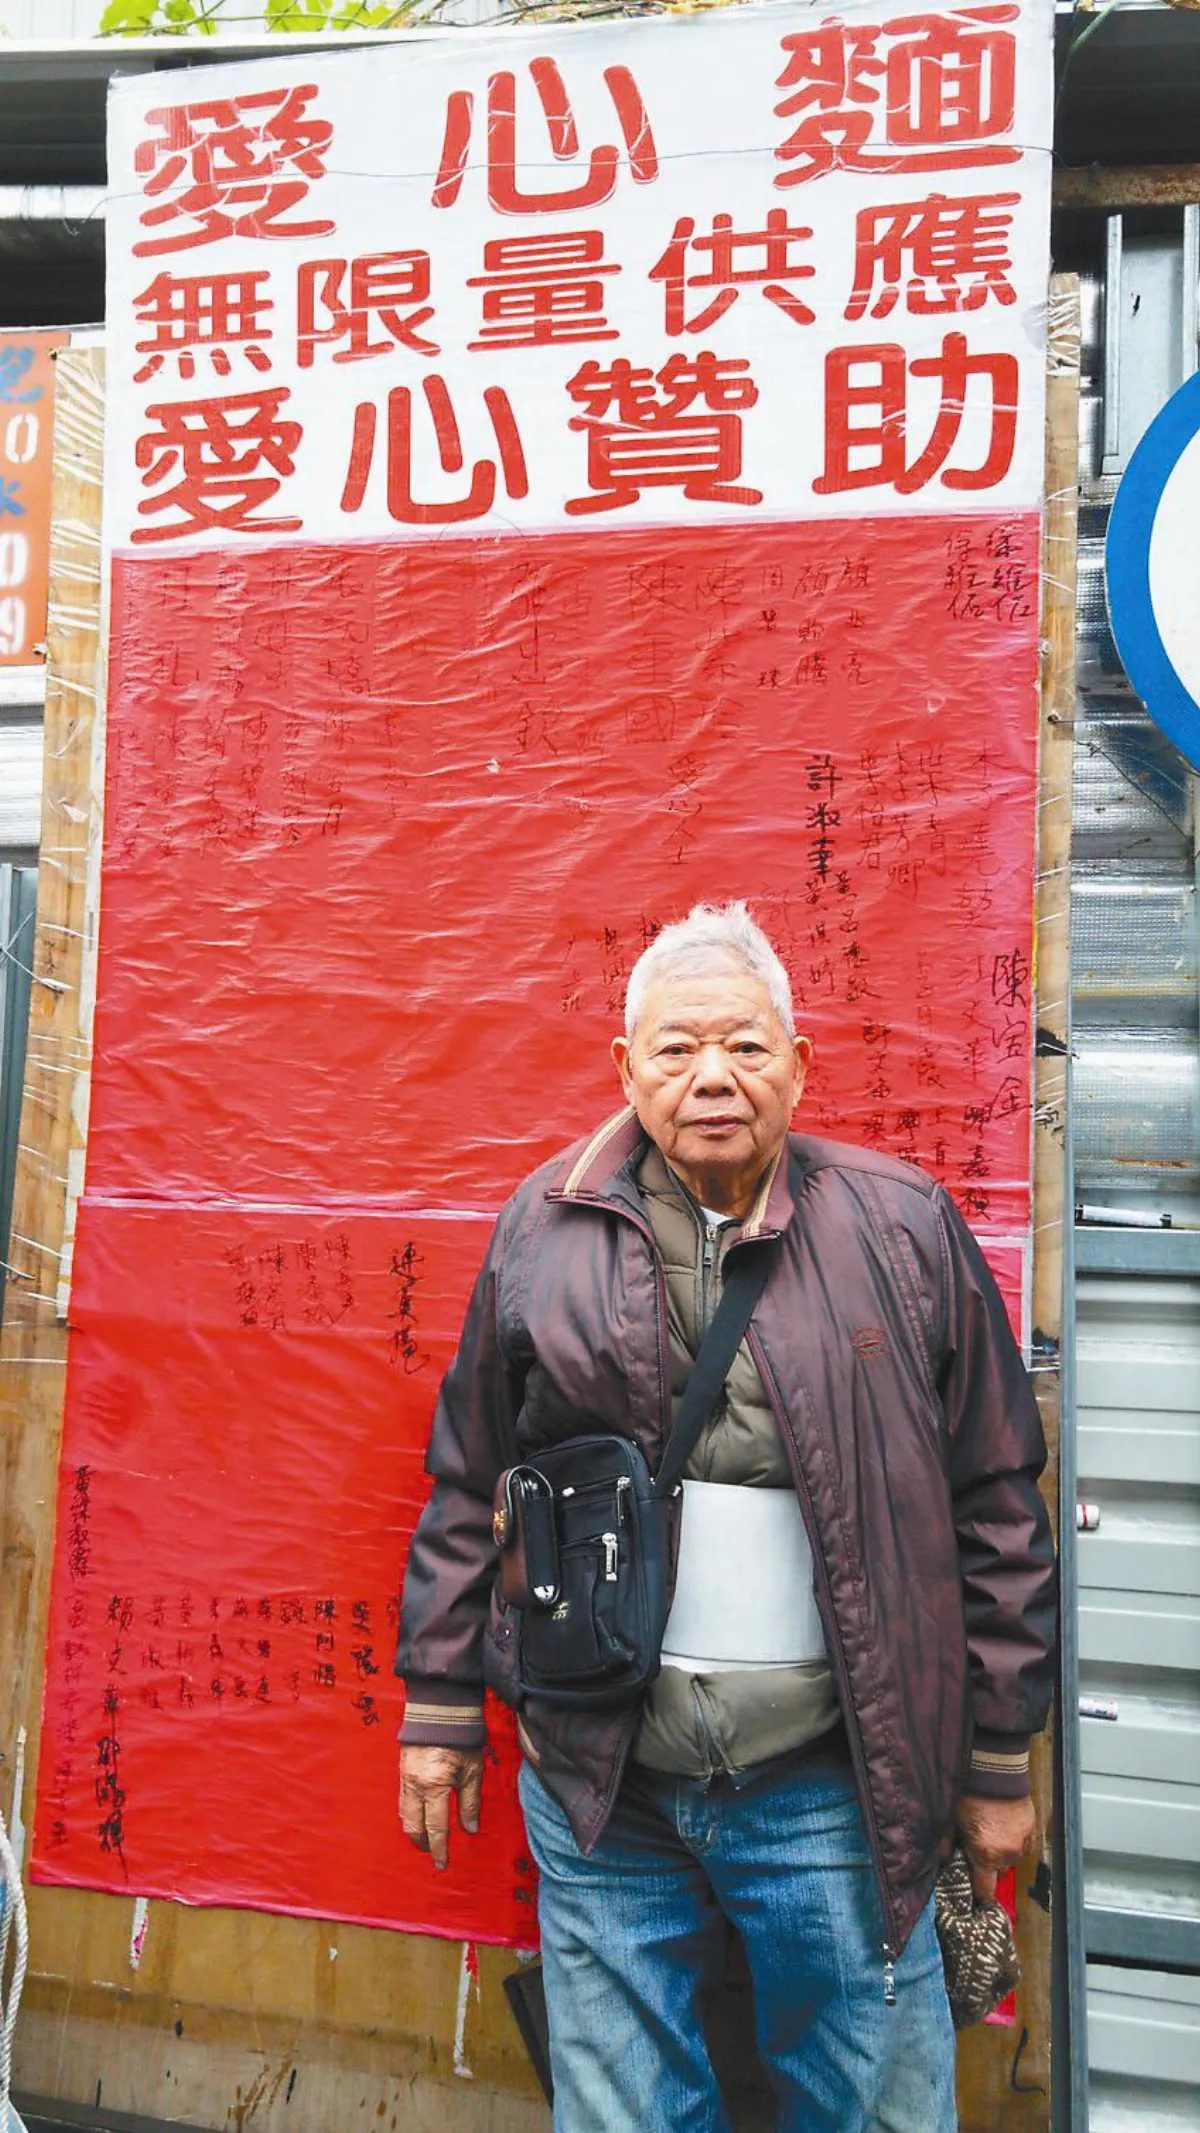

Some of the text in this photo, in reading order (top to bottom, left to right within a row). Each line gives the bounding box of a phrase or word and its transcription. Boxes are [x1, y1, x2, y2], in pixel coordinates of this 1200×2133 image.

[131, 7, 1020, 257] 愛心麵
[132, 192, 1021, 383] 無限量供應
[130, 331, 1020, 545] 愛心贊助
